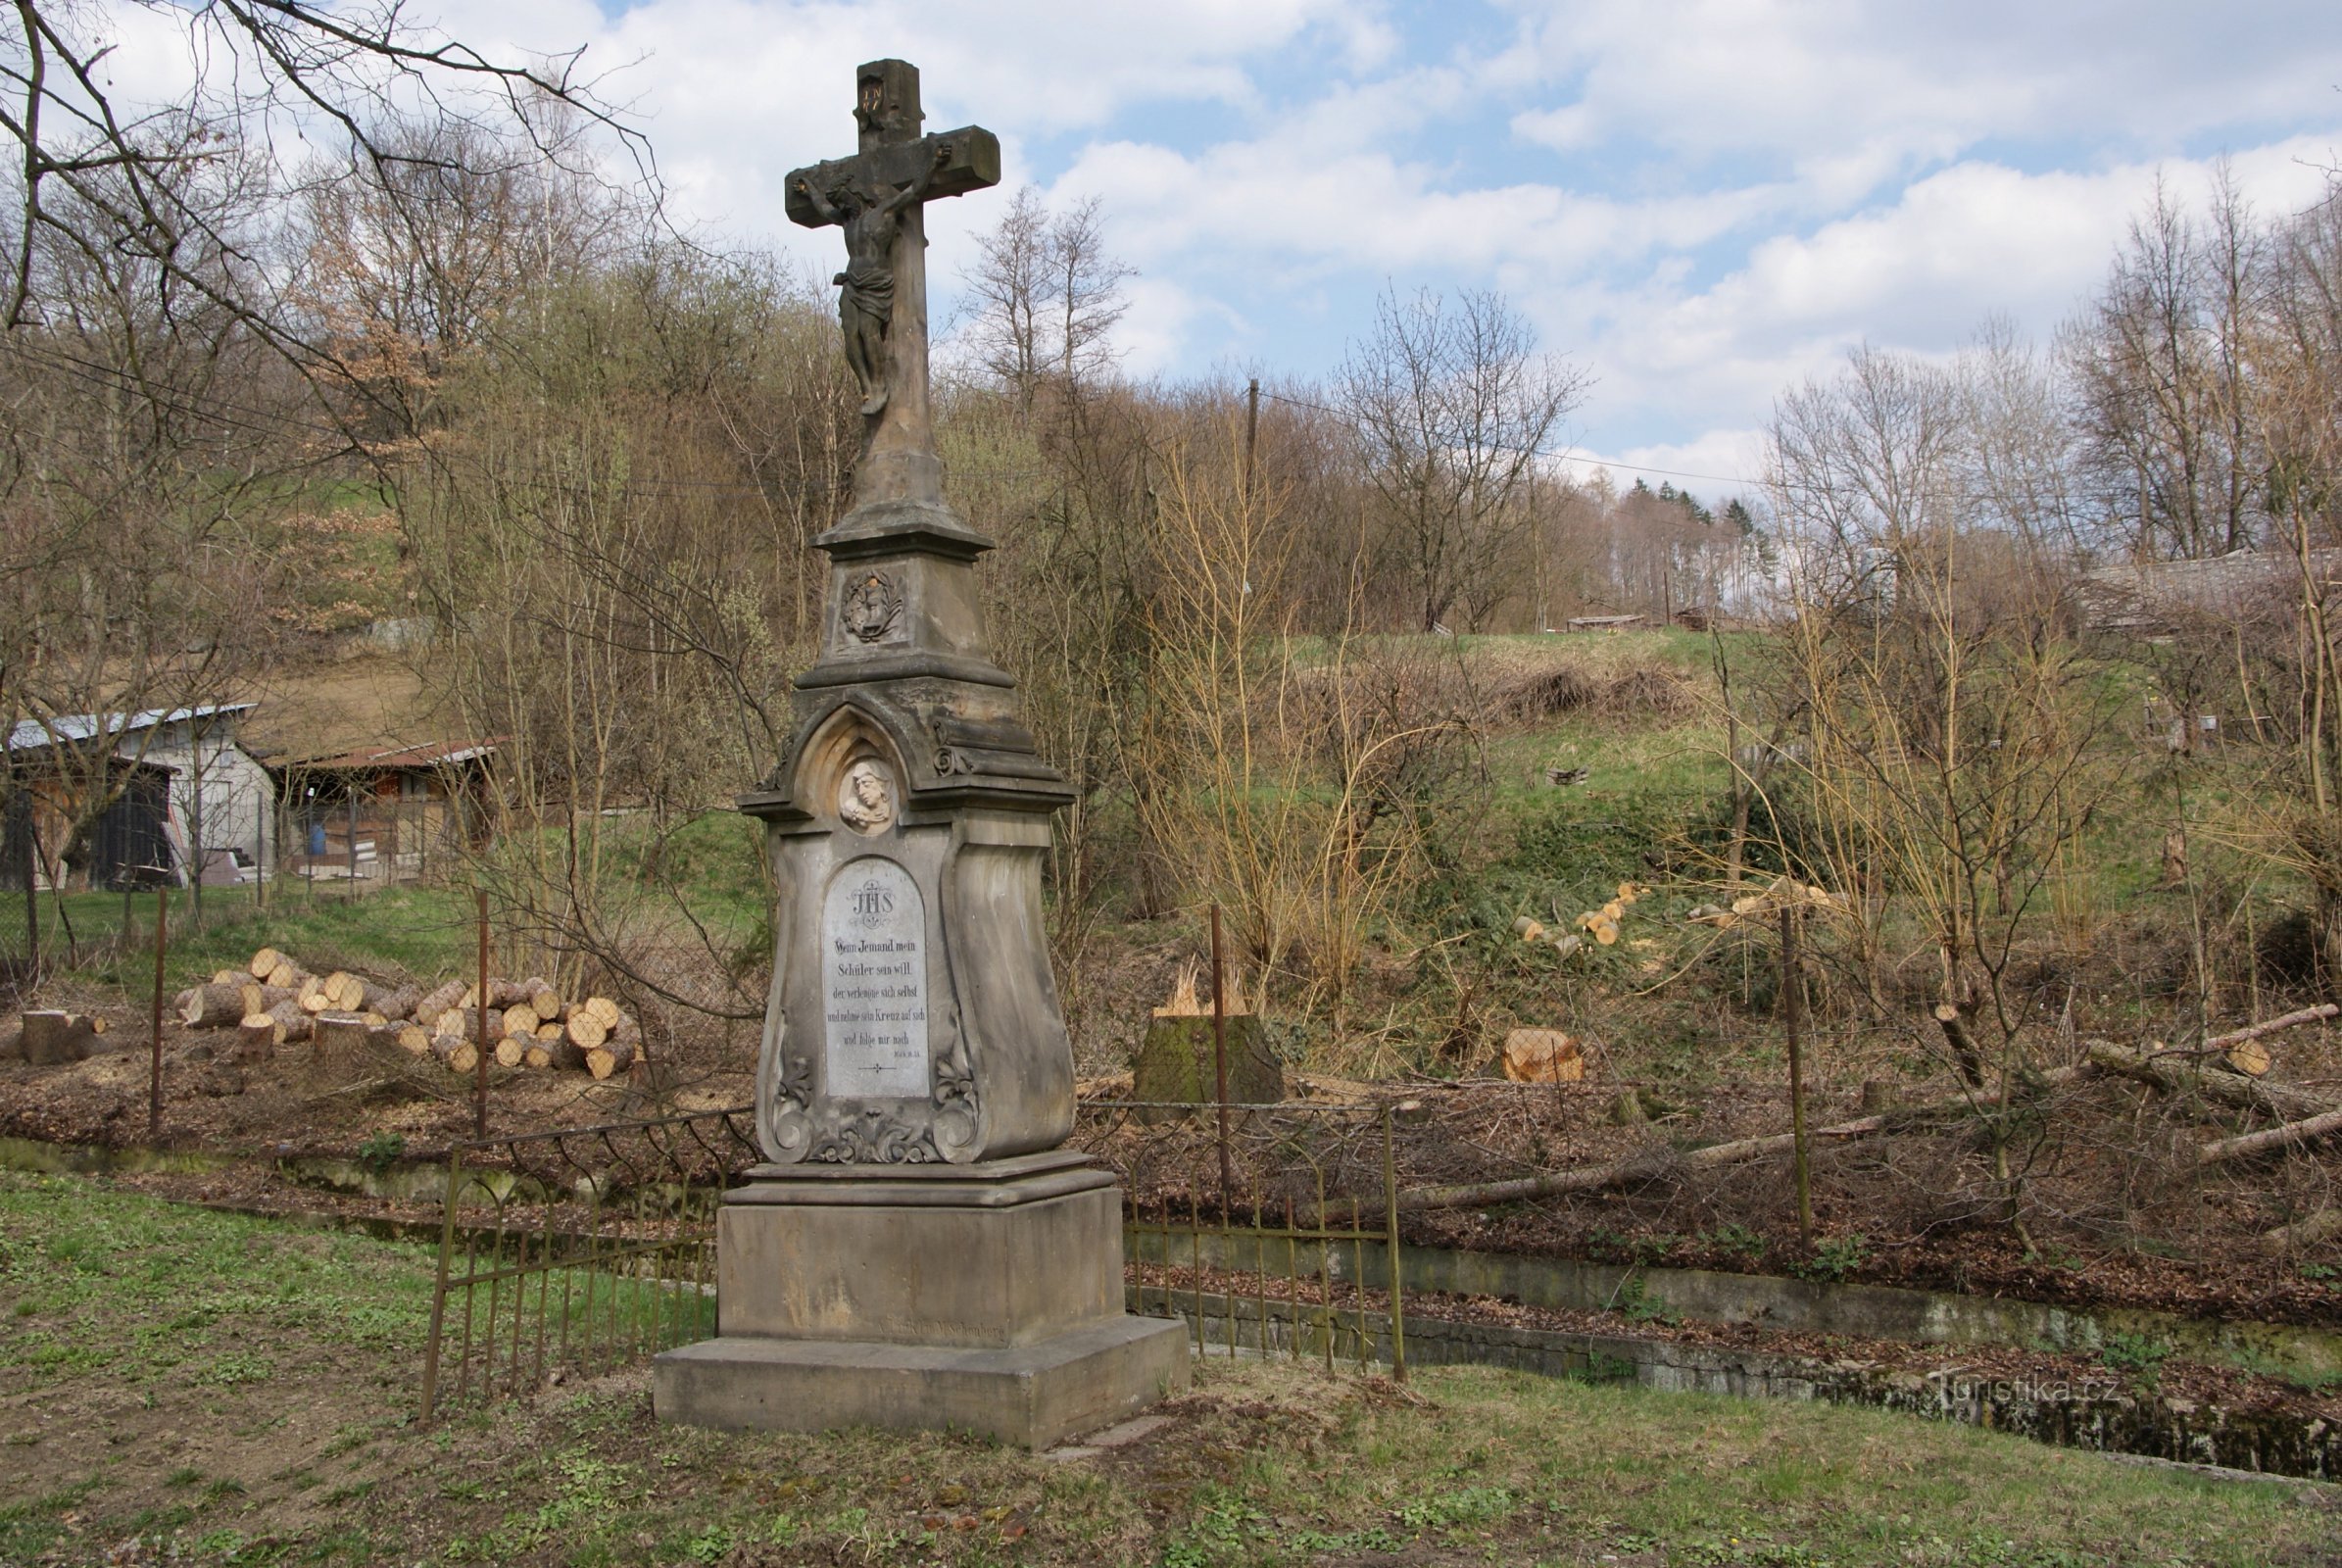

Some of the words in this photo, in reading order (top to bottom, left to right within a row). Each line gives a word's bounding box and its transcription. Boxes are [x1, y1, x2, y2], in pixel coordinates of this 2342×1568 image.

[834, 938, 856, 956] Wenn
[857, 939, 894, 954] Jemand
[896, 940, 916, 952] mein
[838, 962, 874, 977] Schüler
[876, 963, 892, 975] sein
[833, 986, 846, 1000] der
[881, 985, 896, 999] sich
[897, 985, 917, 998] selbst
[827, 1009, 840, 1022] und
[860, 1010, 875, 1022] sein
[875, 1007, 901, 1022] Kreuz
[901, 1007, 912, 1021] auf
[912, 1006, 926, 1021] sich
[844, 1032, 856, 1046] und
[858, 1032, 876, 1049] folge
[878, 1035, 891, 1046] mir
[893, 1031, 909, 1046] nach
